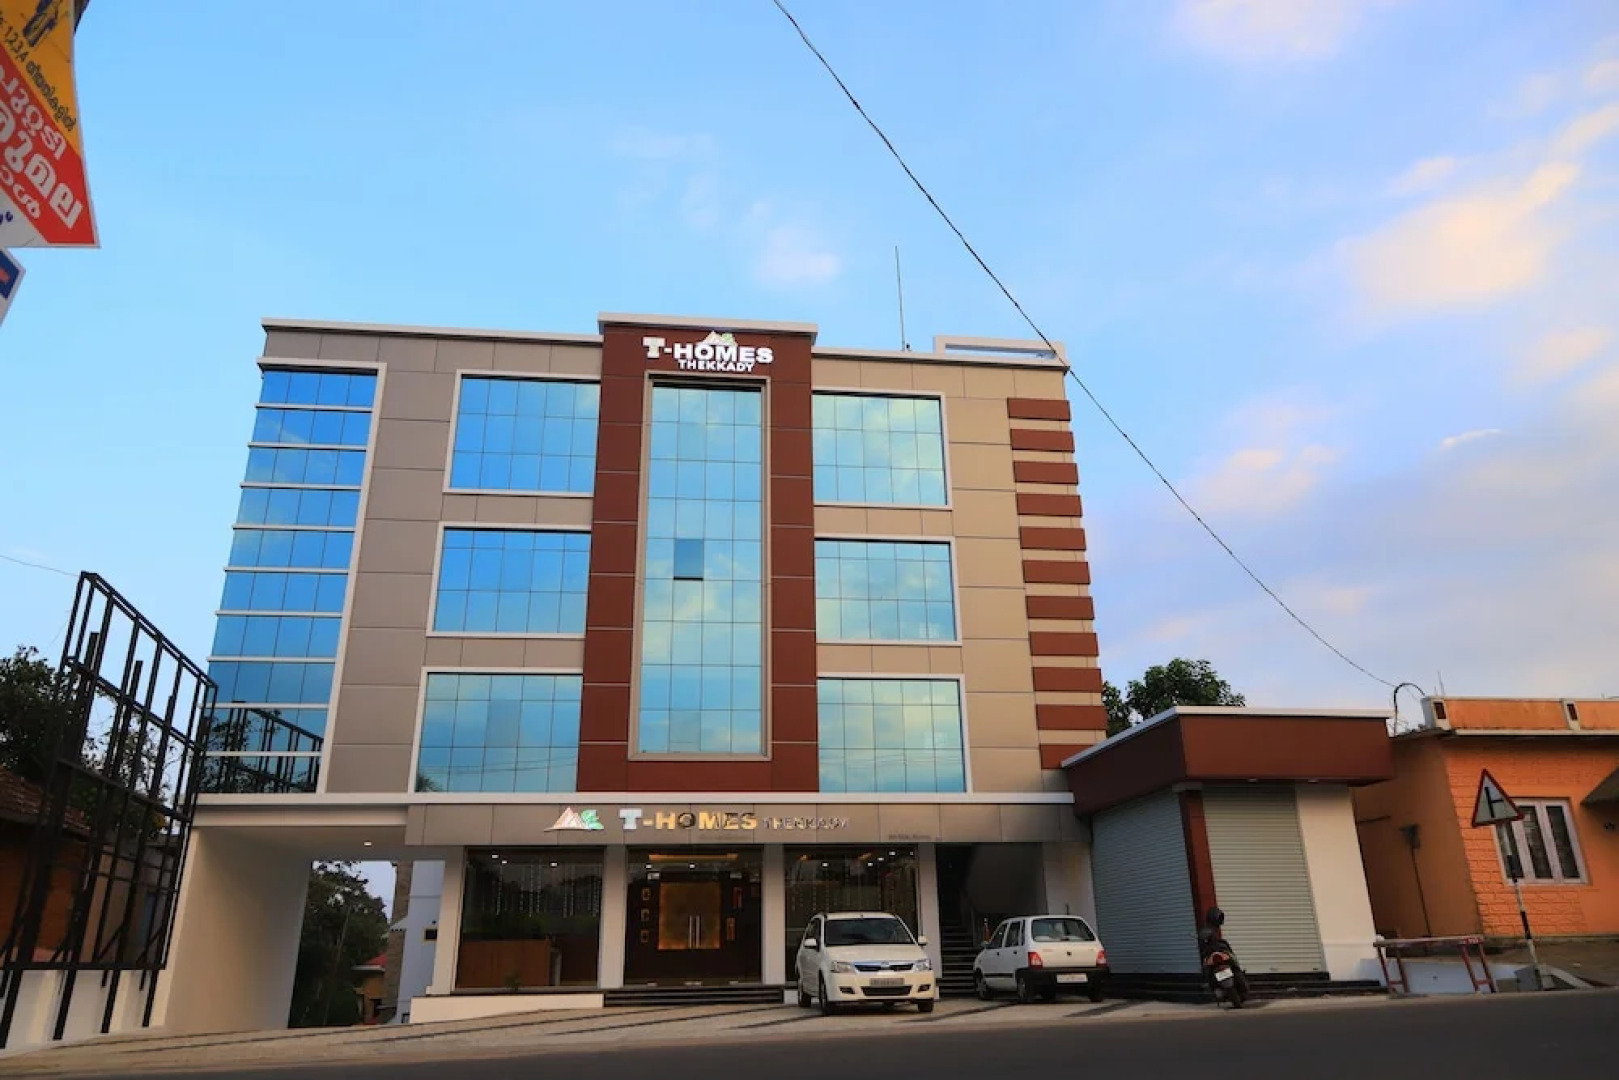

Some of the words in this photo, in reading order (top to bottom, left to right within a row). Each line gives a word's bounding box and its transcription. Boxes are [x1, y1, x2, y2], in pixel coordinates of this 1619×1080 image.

[642, 336, 774, 364] T-HOMES
[677, 359, 755, 372] THEKKADY
[618, 807, 758, 830] T-HOMES
